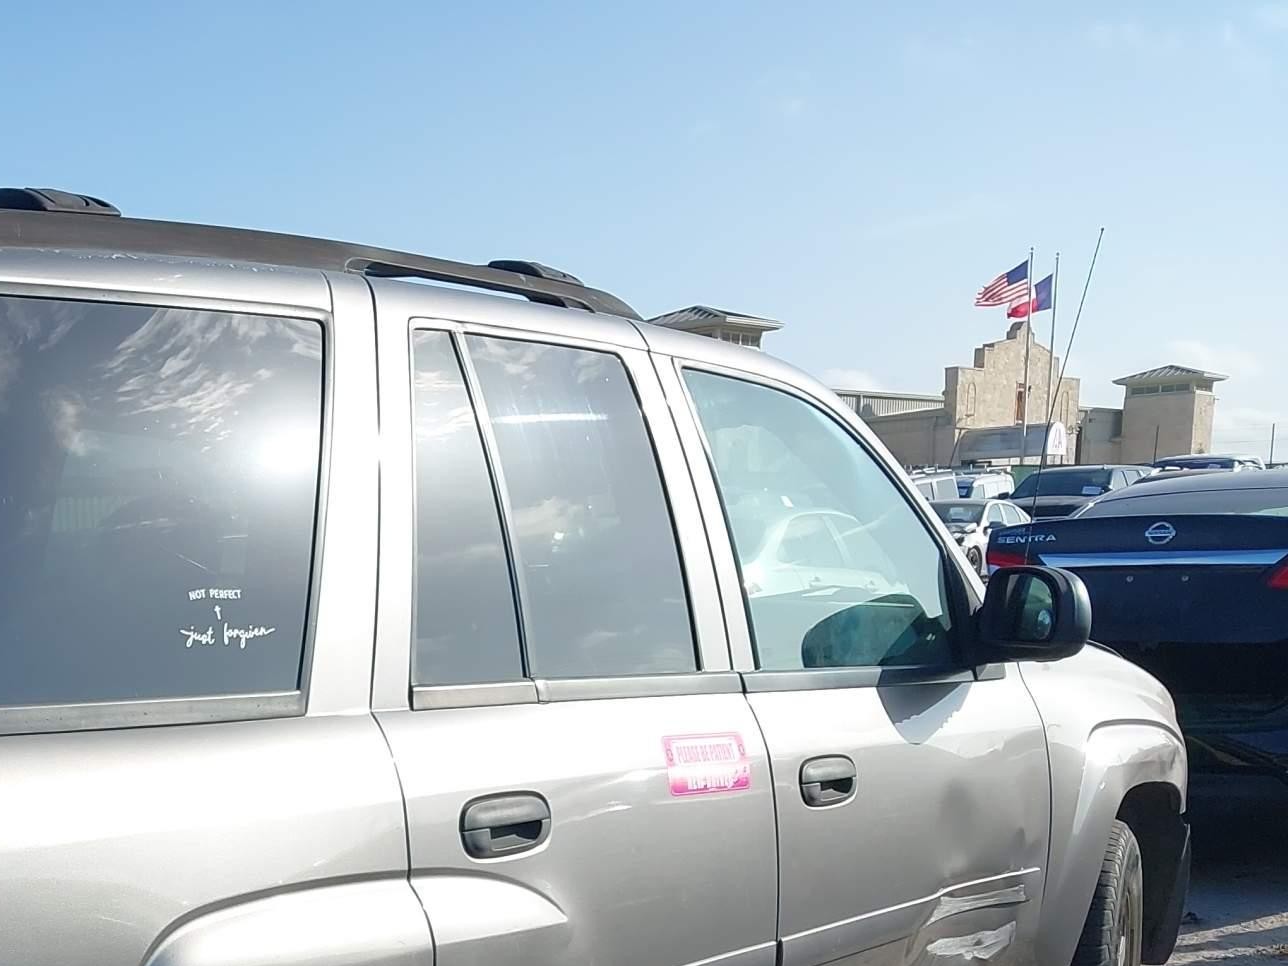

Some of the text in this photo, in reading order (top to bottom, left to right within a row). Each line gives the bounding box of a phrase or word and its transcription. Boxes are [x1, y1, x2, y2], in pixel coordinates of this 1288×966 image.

[998, 534, 1056, 544] SENTRA
[188, 588, 242, 600] NOT PERFECT
[179, 622, 275, 649] just forgiven
